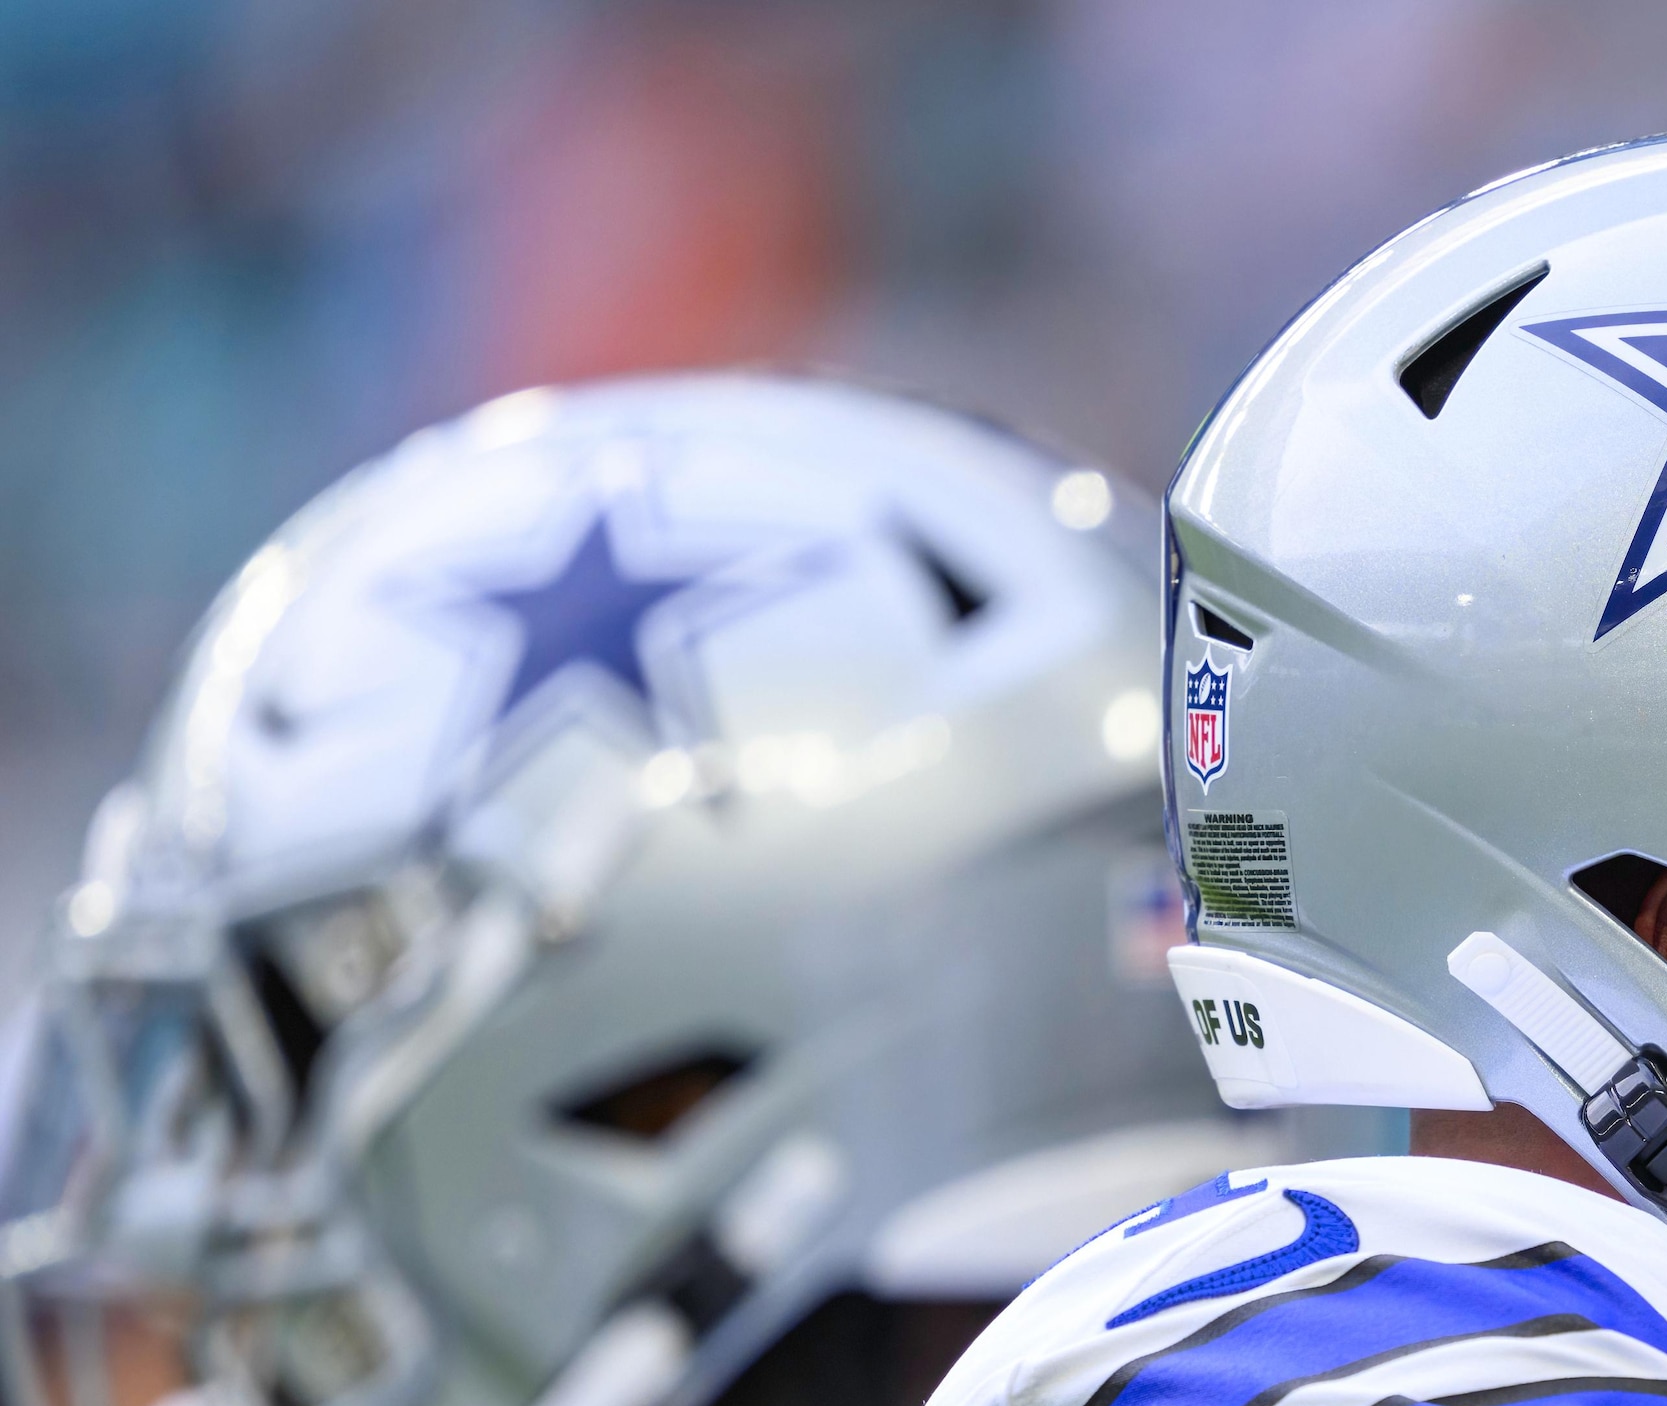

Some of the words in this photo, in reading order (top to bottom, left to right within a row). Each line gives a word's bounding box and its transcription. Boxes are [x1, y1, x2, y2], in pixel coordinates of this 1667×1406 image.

[1188, 712, 1221, 770] NFL
[1203, 813, 1254, 824] WARNING
[1192, 999, 1221, 1045] OF
[1222, 999, 1265, 1049] US
